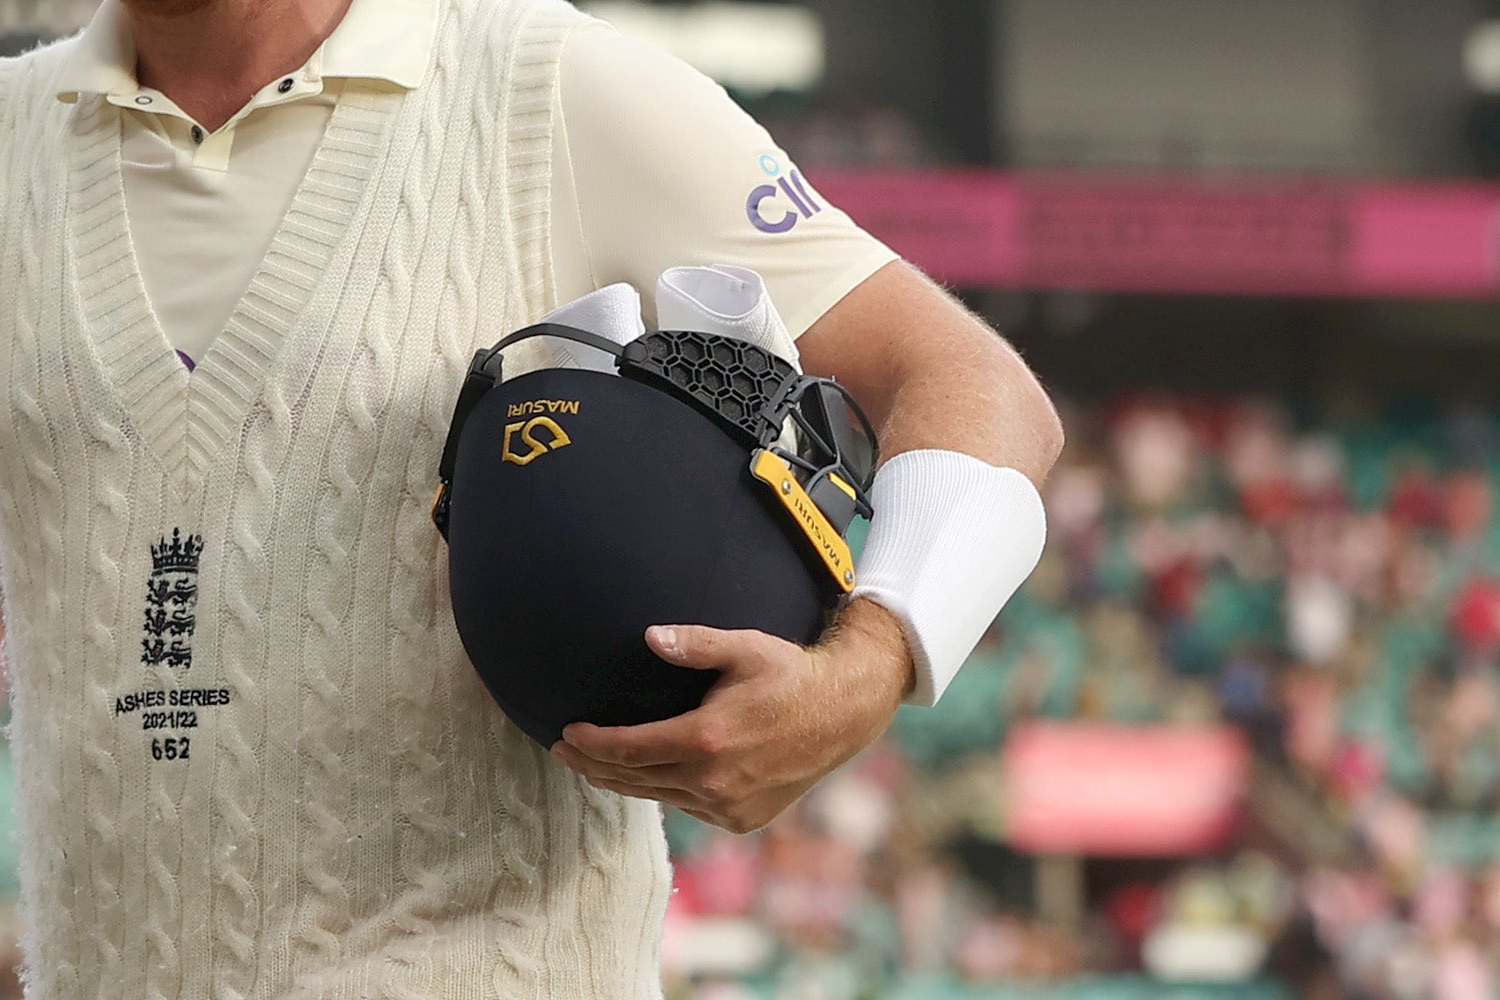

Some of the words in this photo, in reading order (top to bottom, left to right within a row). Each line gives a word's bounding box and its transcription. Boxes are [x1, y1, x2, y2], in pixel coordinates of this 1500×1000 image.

[507, 400, 580, 417] MASURI
[795, 498, 841, 567] MASURI
[116, 691, 165, 716] ASHES
[169, 689, 230, 706] SERIES
[143, 711, 198, 729] 2021/22
[151, 737, 190, 760] 652
